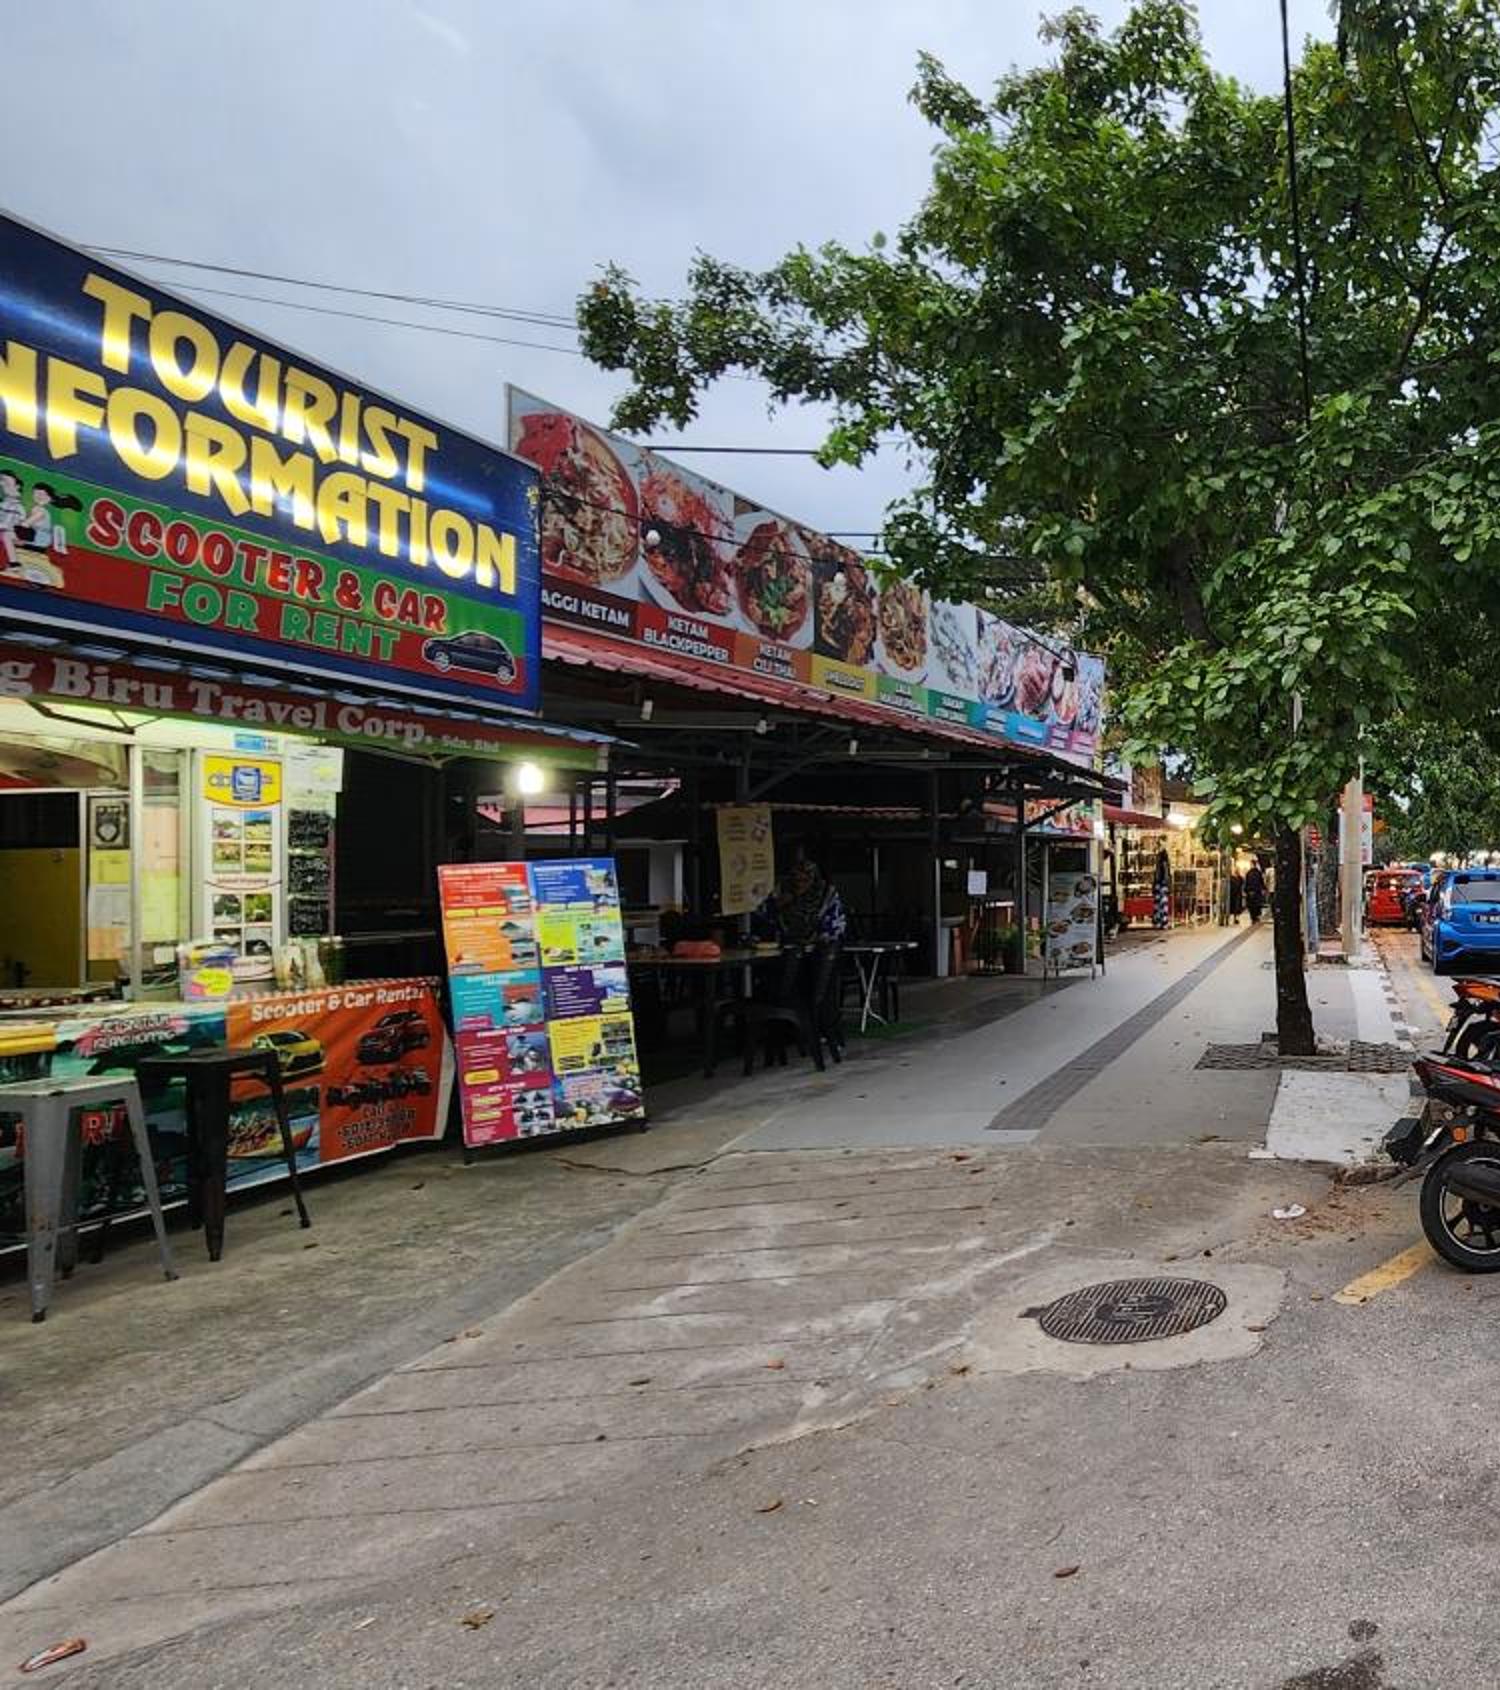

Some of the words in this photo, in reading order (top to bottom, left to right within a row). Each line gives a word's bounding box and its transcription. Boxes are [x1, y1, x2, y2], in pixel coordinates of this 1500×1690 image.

[82, 272, 439, 492] TOURIST
[87, 498, 325, 602] SCOOTER
[335, 570, 363, 613] &
[373, 580, 447, 634] CAR
[146, 569, 259, 633] FOR
[280, 603, 400, 661] RENT
[581, 600, 630, 627] KETAM
[668, 616, 709, 640] KETAM
[643, 628, 730, 662] BLACKPEPPER
[49, 658, 175, 709] Biru
[188, 681, 326, 730] Travel
[251, 999, 325, 1023] Scooter
[327, 993, 342, 1011] &
[343, 990, 375, 1009] Car
